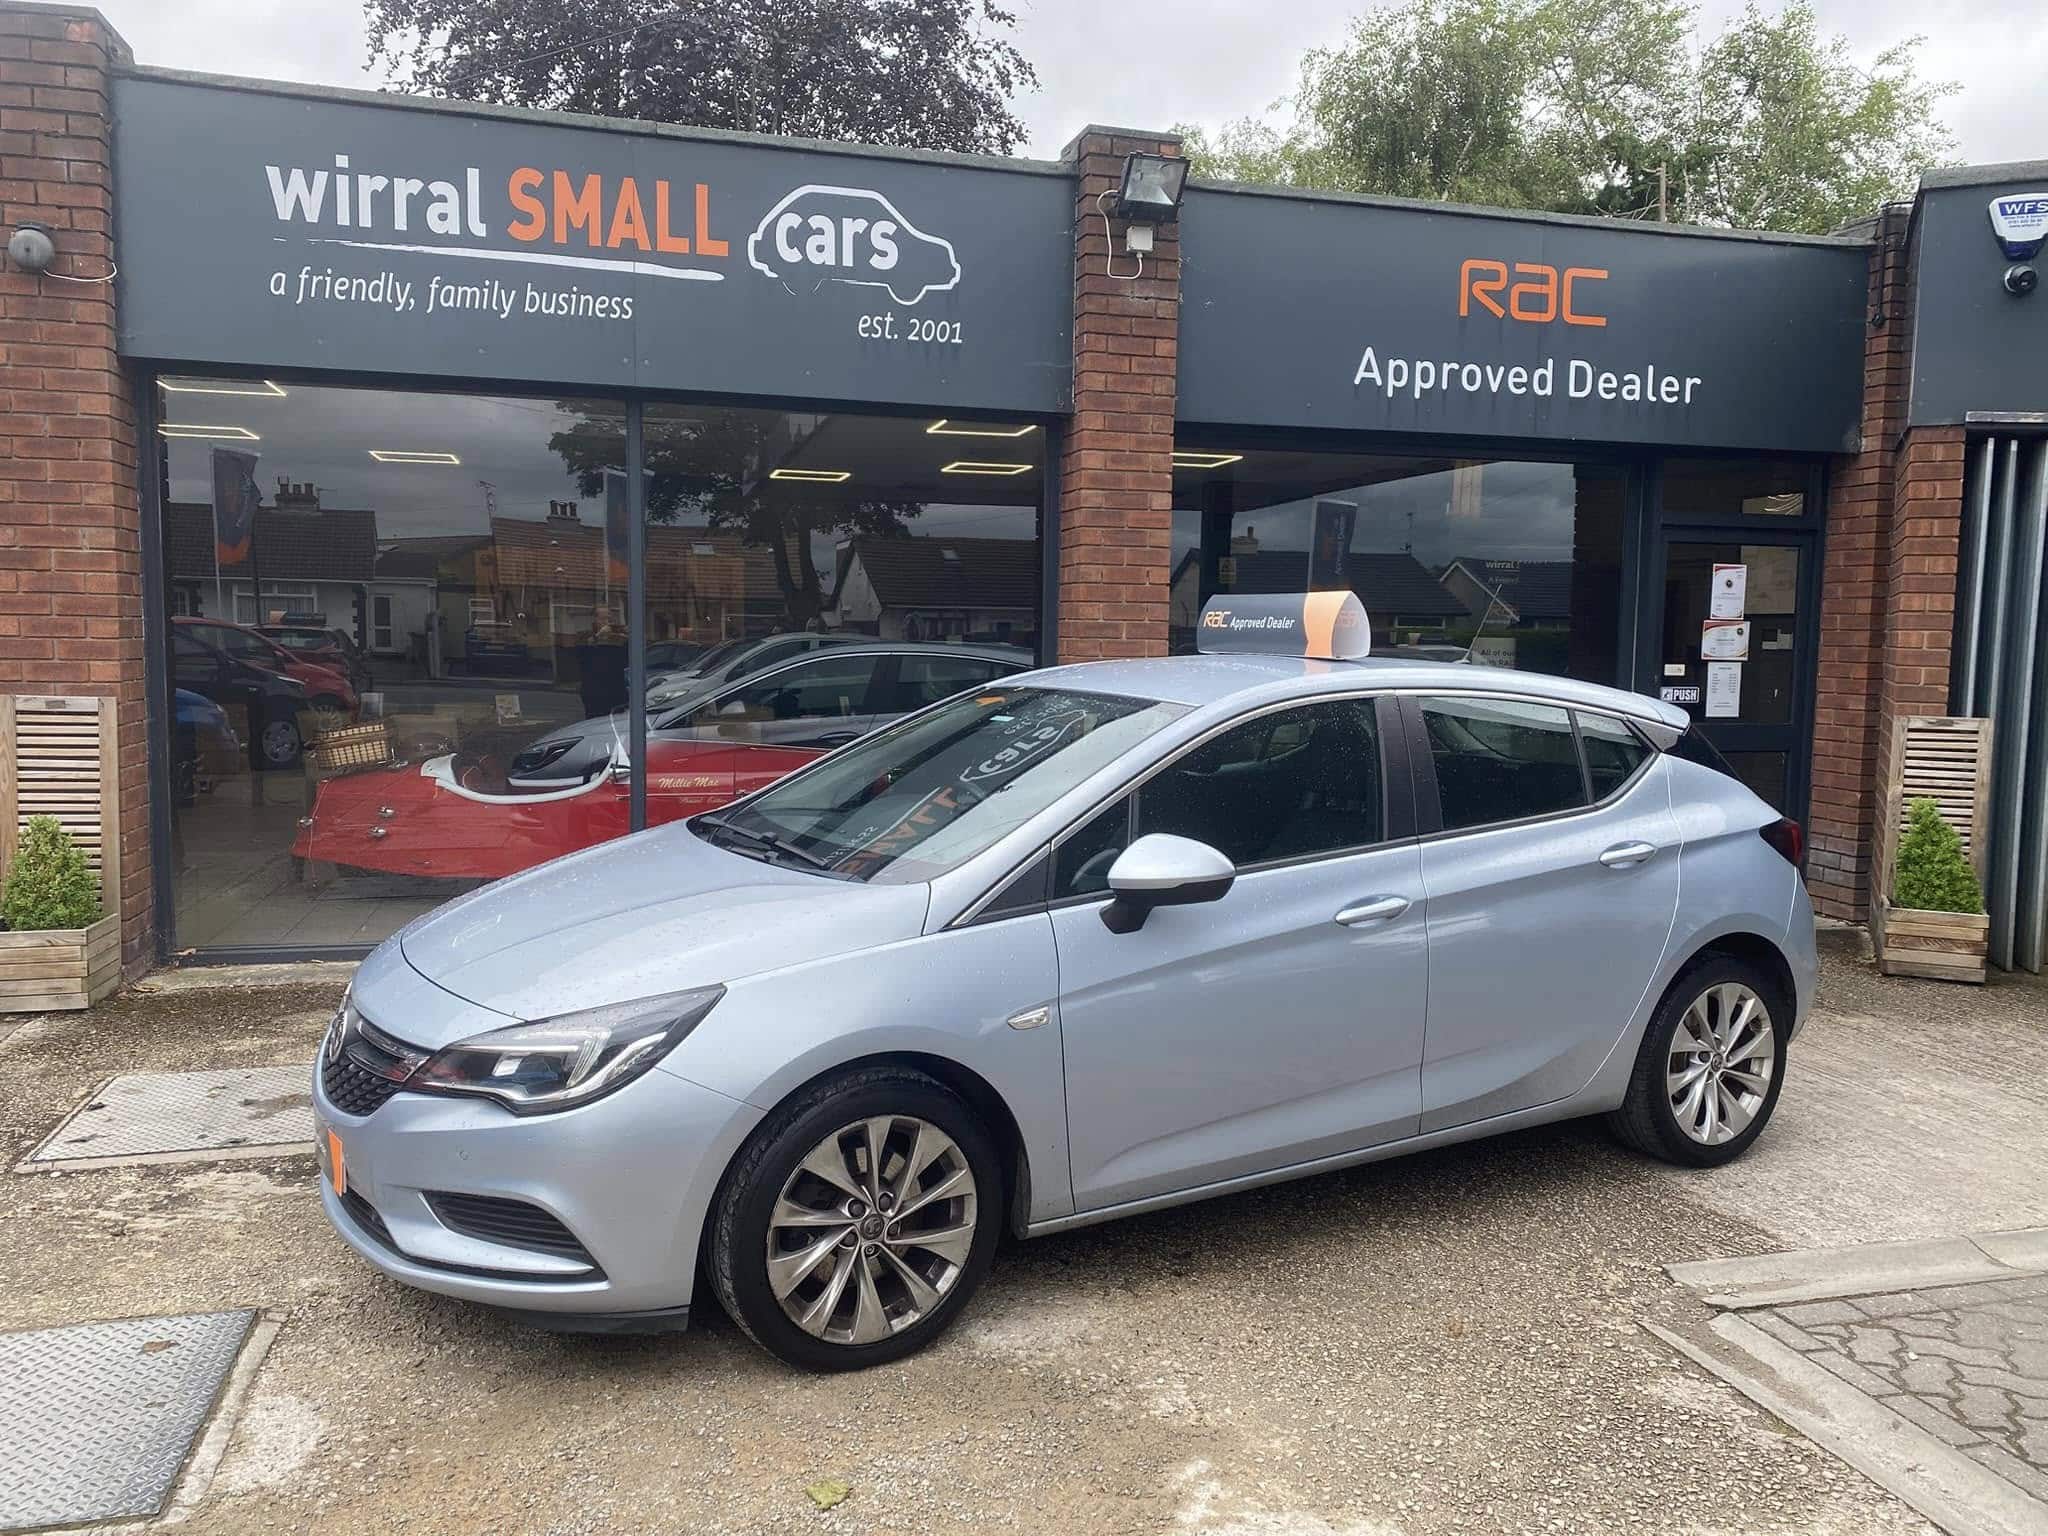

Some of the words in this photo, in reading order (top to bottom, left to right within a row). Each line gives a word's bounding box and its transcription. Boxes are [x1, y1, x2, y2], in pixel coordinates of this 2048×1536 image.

[265, 153, 488, 239] wirral
[507, 167, 729, 257] SMALL
[775, 211, 899, 272] cars
[2005, 201, 2048, 215] WFS
[269, 271, 287, 297] a
[294, 264, 416, 313] friendly,
[426, 274, 517, 320] family
[524, 281, 634, 320] business
[858, 311, 902, 341] est.
[907, 317, 963, 345] 2001
[1353, 345, 1555, 401] Approved
[1567, 358, 1703, 405] Dealer
[1230, 616, 1266, 631] Approved
[1266, 616, 1296, 629] Dealer
[1673, 688, 1697, 701] PUSH
